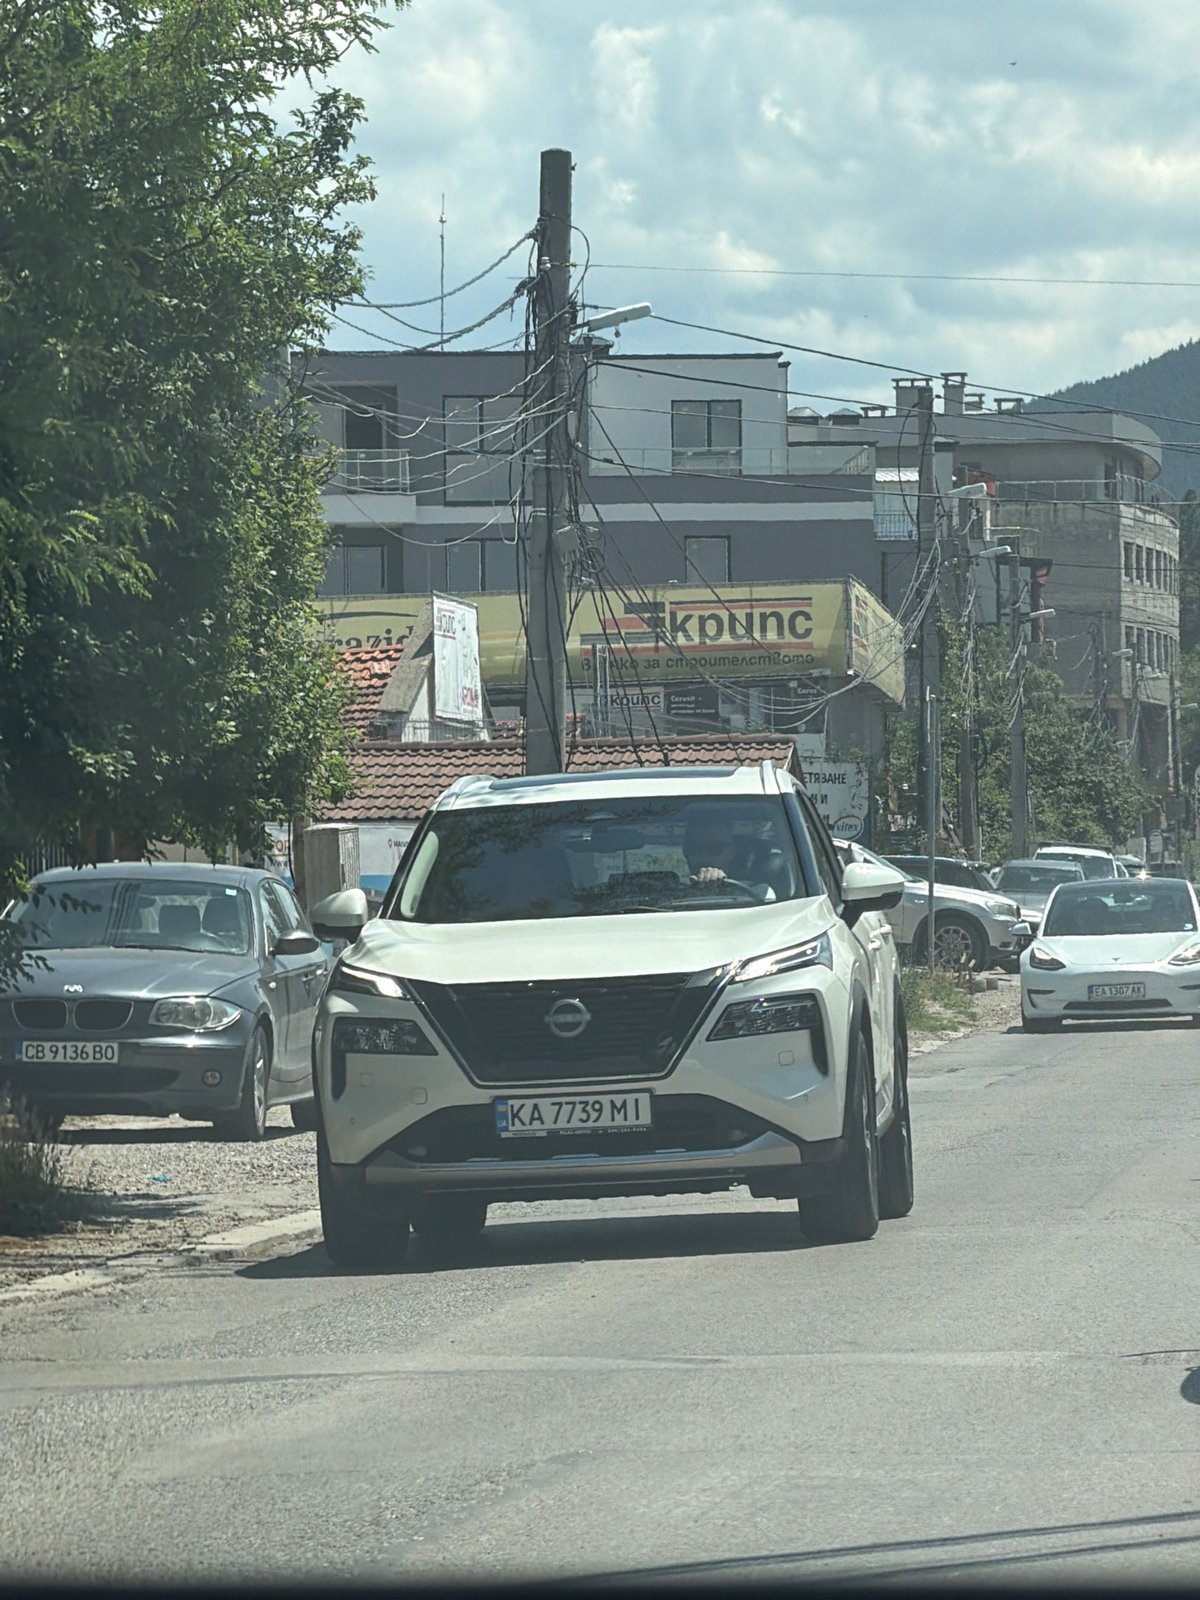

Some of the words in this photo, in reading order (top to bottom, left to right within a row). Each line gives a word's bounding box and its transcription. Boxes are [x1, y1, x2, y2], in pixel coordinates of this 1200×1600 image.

[25, 1043, 46, 1060] CB
[49, 1044, 89, 1060] 9136
[510, 1103, 545, 1127] KA
[550, 1100, 604, 1125] 7739
[610, 1098, 640, 1123] MI
